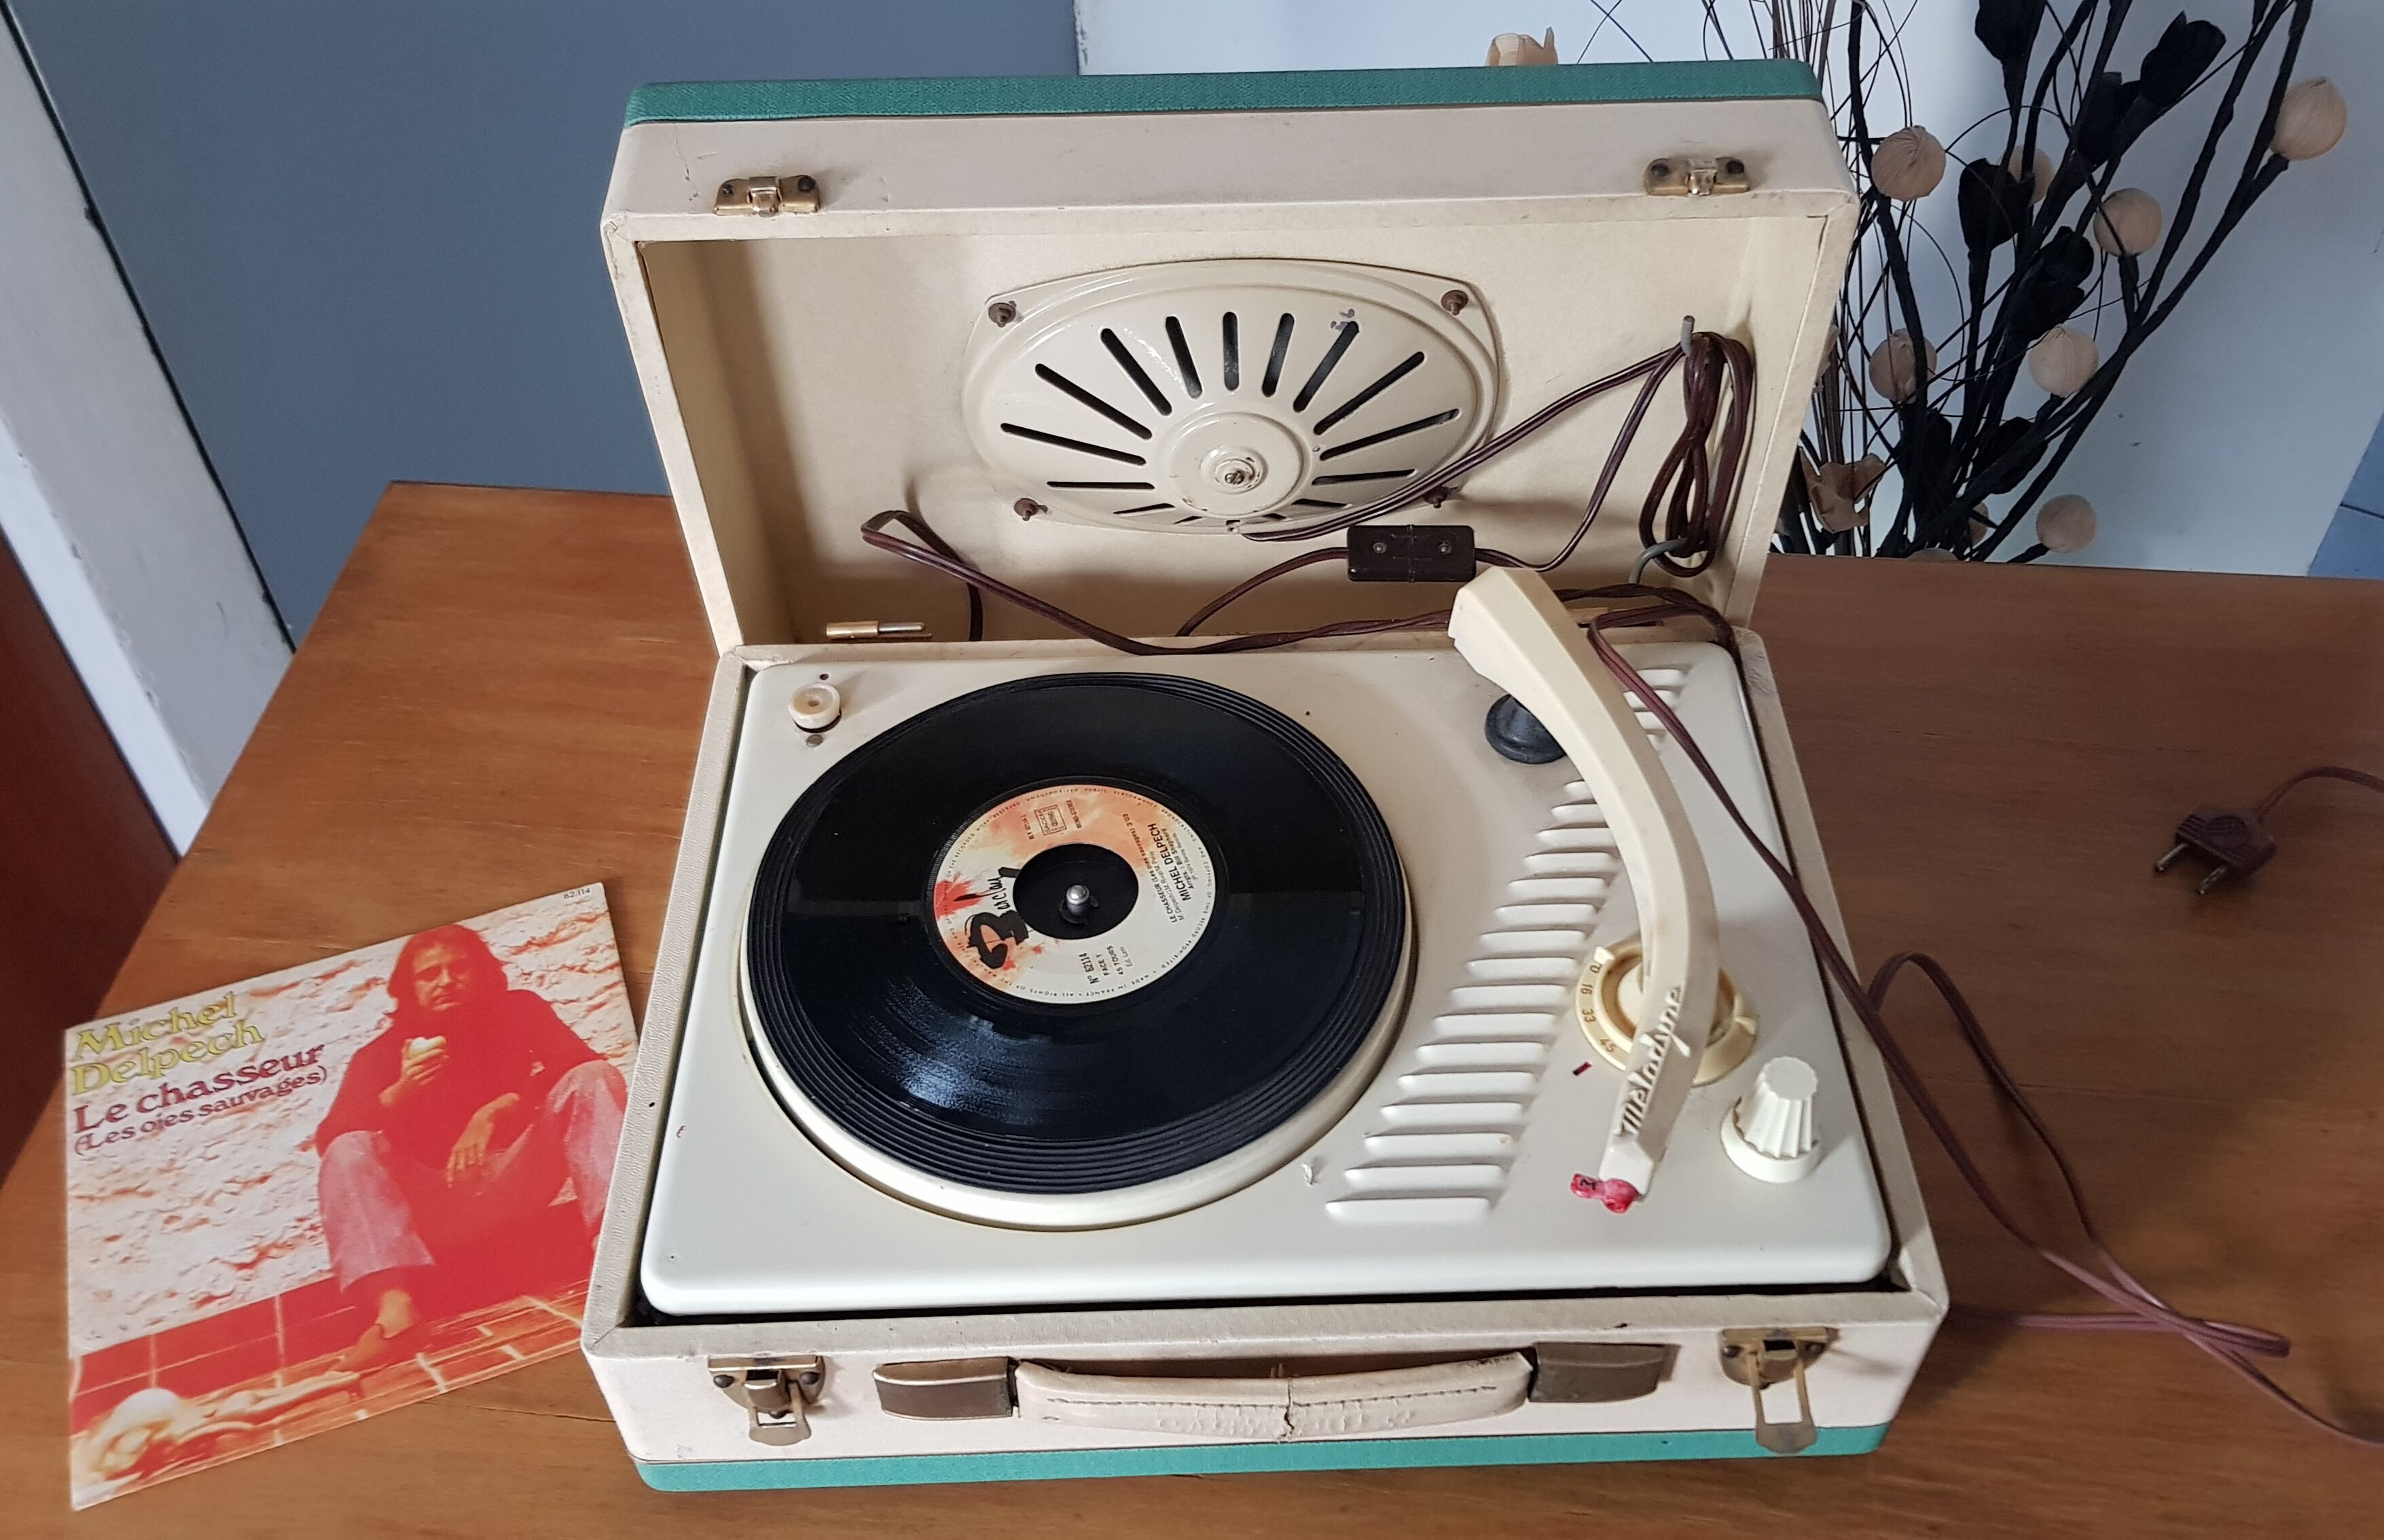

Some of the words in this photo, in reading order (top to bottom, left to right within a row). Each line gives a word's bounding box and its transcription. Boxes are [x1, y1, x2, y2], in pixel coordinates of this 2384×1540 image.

[1128, 828, 1147, 856] sauvages)
[1146, 822, 1174, 865] DELPECH
[1160, 827, 1178, 854] Shepherd
[1147, 870, 1159, 882] (Les
[1167, 866, 1191, 901] MICHEL
[1153, 883, 1173, 914] CHASSEUR
[952, 866, 1029, 969] Barclay
[1168, 915, 1177, 923] LE
[1077, 952, 1095, 972] 62114
[1097, 959, 1110, 976] FACE
[1106, 945, 1121, 966] TOURS
[1115, 966, 1125, 975] 45
[1581, 983, 1593, 994] 16
[75, 991, 237, 1061] Michel
[1582, 1008, 1595, 1023] 33
[71, 1019, 266, 1095] Delpech
[1600, 1038, 1615, 1052] 45
[74, 1103, 128, 1133] Le
[137, 1044, 325, 1114] chasseur
[75, 1124, 135, 1156] (Les
[140, 1108, 196, 1133] oies
[196, 1065, 327, 1116] sauvages)
